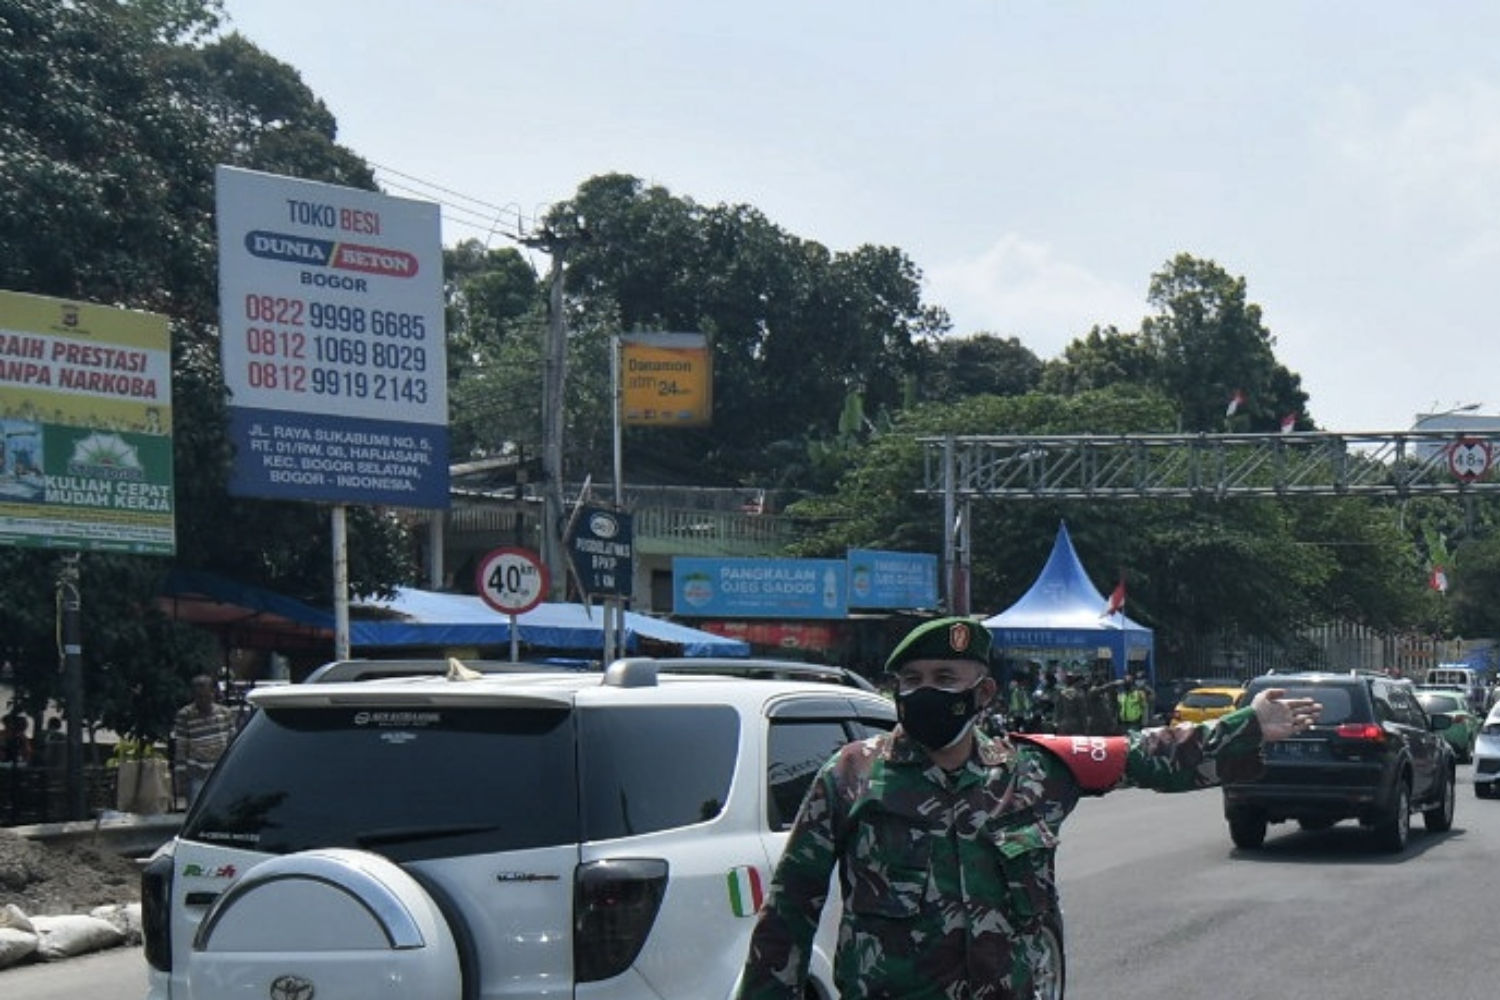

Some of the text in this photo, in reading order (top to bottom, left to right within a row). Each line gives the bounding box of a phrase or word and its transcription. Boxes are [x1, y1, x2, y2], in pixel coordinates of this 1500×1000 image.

[286, 200, 380, 236] TOKO BESI
[254, 236, 410, 272] DUNIA BETON
[300, 271, 367, 292] BOGOR
[245, 294, 426, 340] 0822 9998 6685
[51, 341, 148, 373] PRESTASI
[247, 327, 427, 372] 0812 1069 8029
[59, 367, 157, 399] NARKOBA
[248, 361, 428, 404] 0812 9919 2143
[274, 426, 311, 440] RAYA
[315, 429, 390, 447] SUKABUMI
[263, 455, 298, 469] KEC.
[302, 458, 354, 474] BOGOR
[270, 470, 325, 485] BOGOR
[45, 475, 171, 498] KULIAH CEPAT
[45, 489, 171, 511] MUDAH KERJA
[488, 564, 521, 593] 40
[721, 567, 816, 581] PANGKALAN
[721, 581, 760, 594] OJEG
